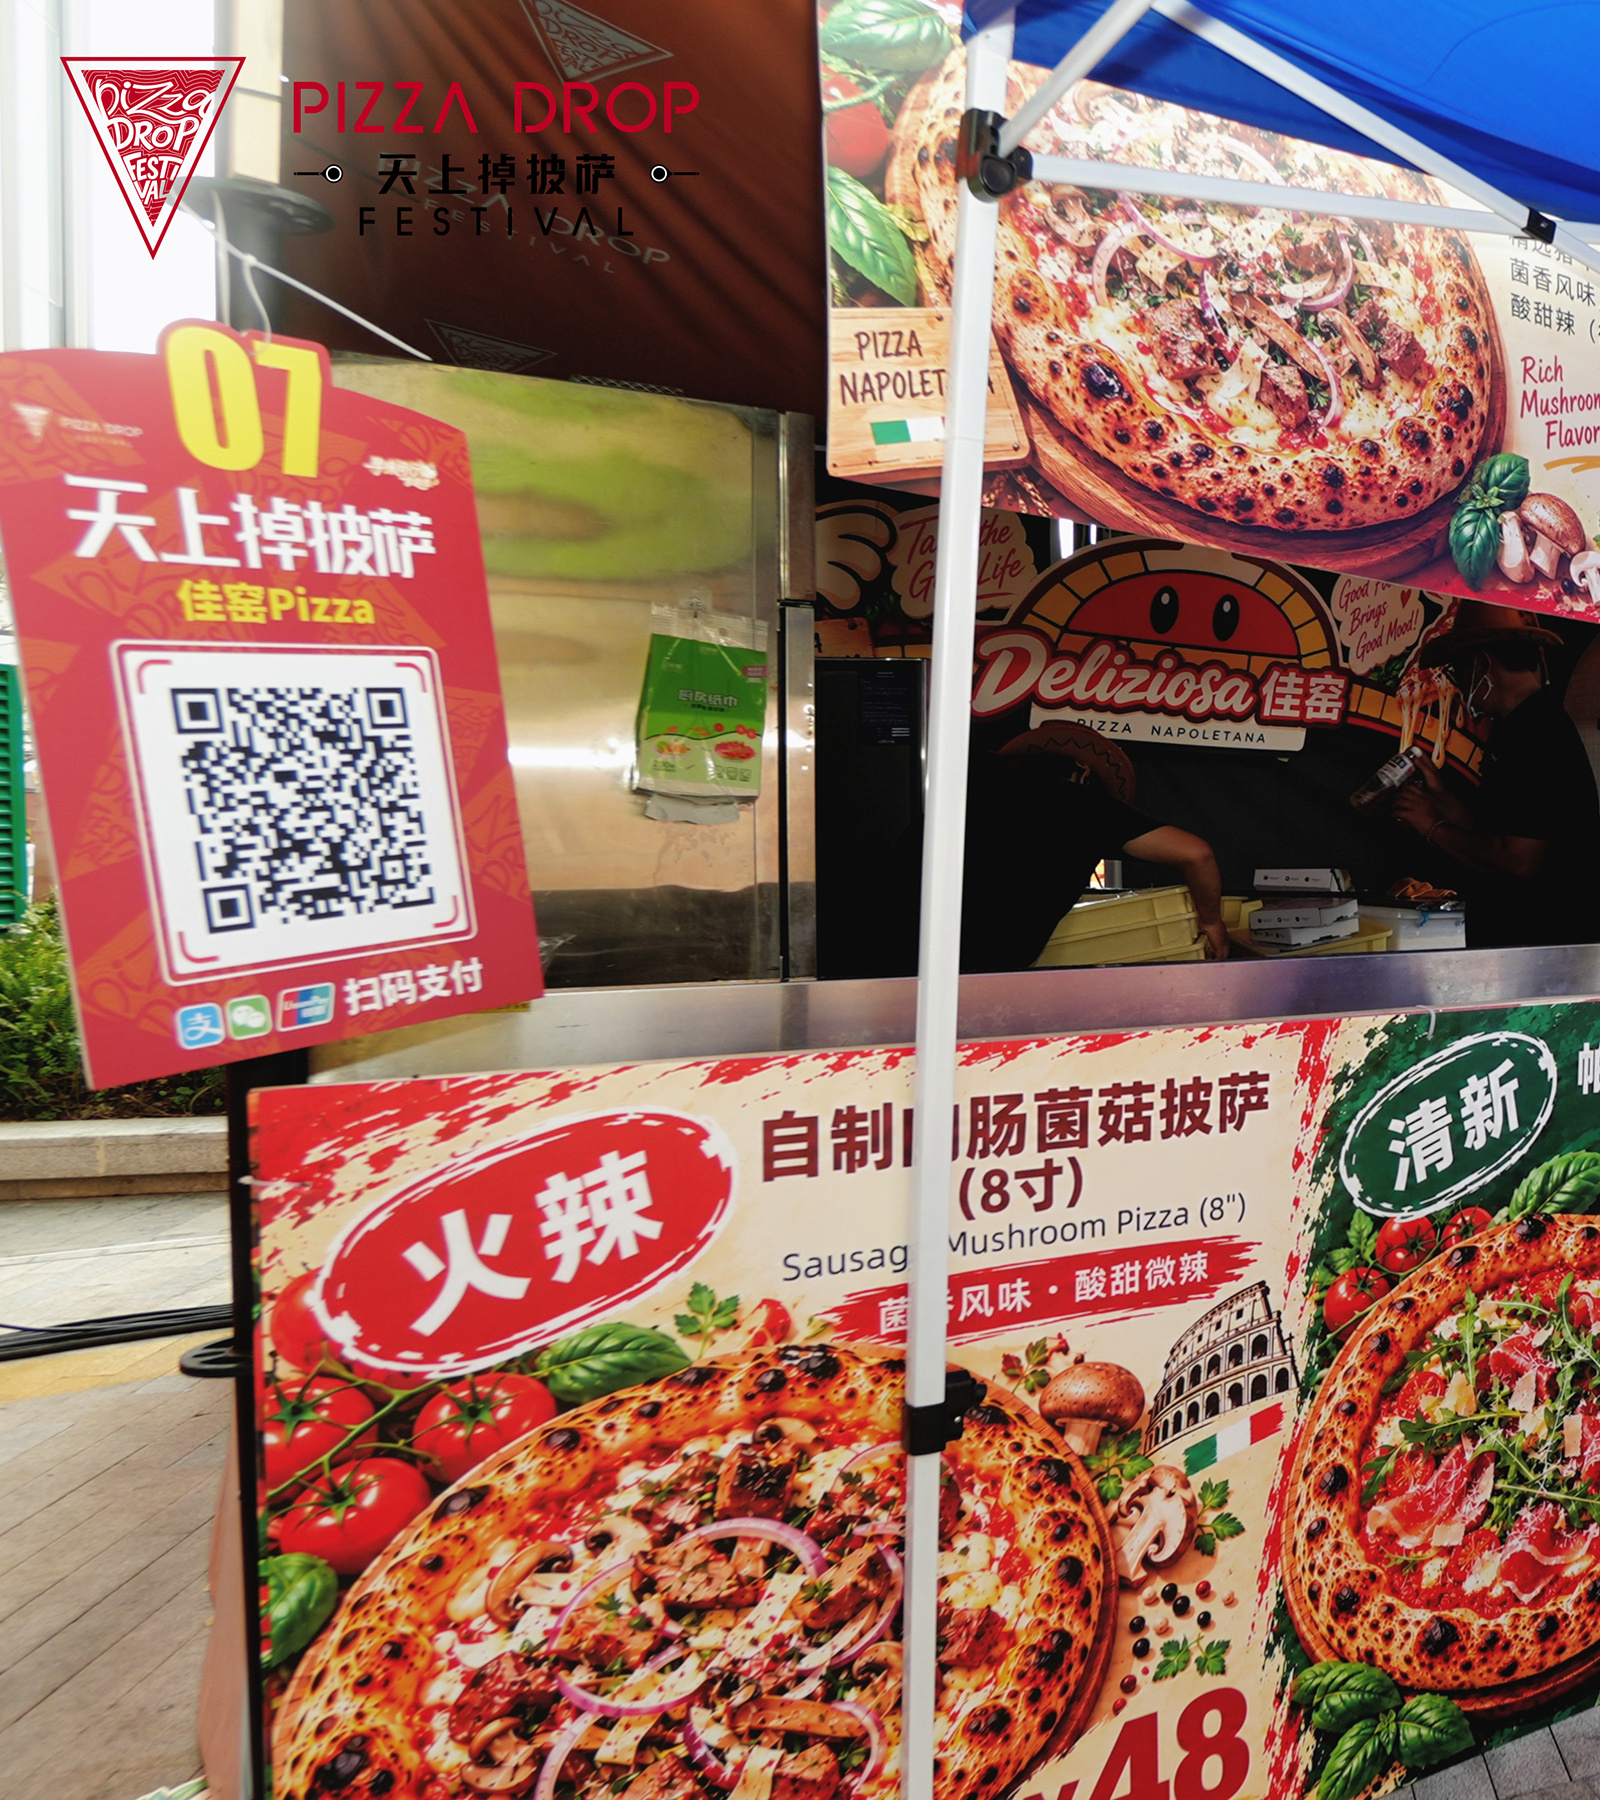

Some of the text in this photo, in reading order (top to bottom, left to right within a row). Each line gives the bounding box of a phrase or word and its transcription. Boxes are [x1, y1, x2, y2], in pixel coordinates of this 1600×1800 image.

[854, 330, 923, 360] PIZZA
[1520, 355, 1564, 385] Rich
[166, 325, 322, 478] 07
[64, 473, 437, 579] 天上掉披萨
[977, 547, 1026, 590] Life
[1339, 578, 1371, 613] Good
[176, 579, 376, 625] 佳窑Pizza
[1348, 601, 1389, 636] Brings
[1356, 624, 1386, 663] Good
[971, 634, 1255, 715] Deliziosa
[1261, 669, 1346, 722] 佳窑
[1077, 718, 1266, 744] PIZZA NAPOLETANA
[343, 956, 484, 1017] 扫码支付
[761, 1071, 1271, 1182] 自制肠菌菇披萨
[1388, 1058, 1520, 1191] 清新
[957, 1156, 1084, 1221] (8寸)
[401, 1150, 664, 1337] 火辣
[782, 1243, 909, 1283] Sausag
[948, 1210, 1106, 1259] Mushroom
[1117, 1203, 1190, 1236] Pizza
[1022, 1687, 1250, 1800] 48
